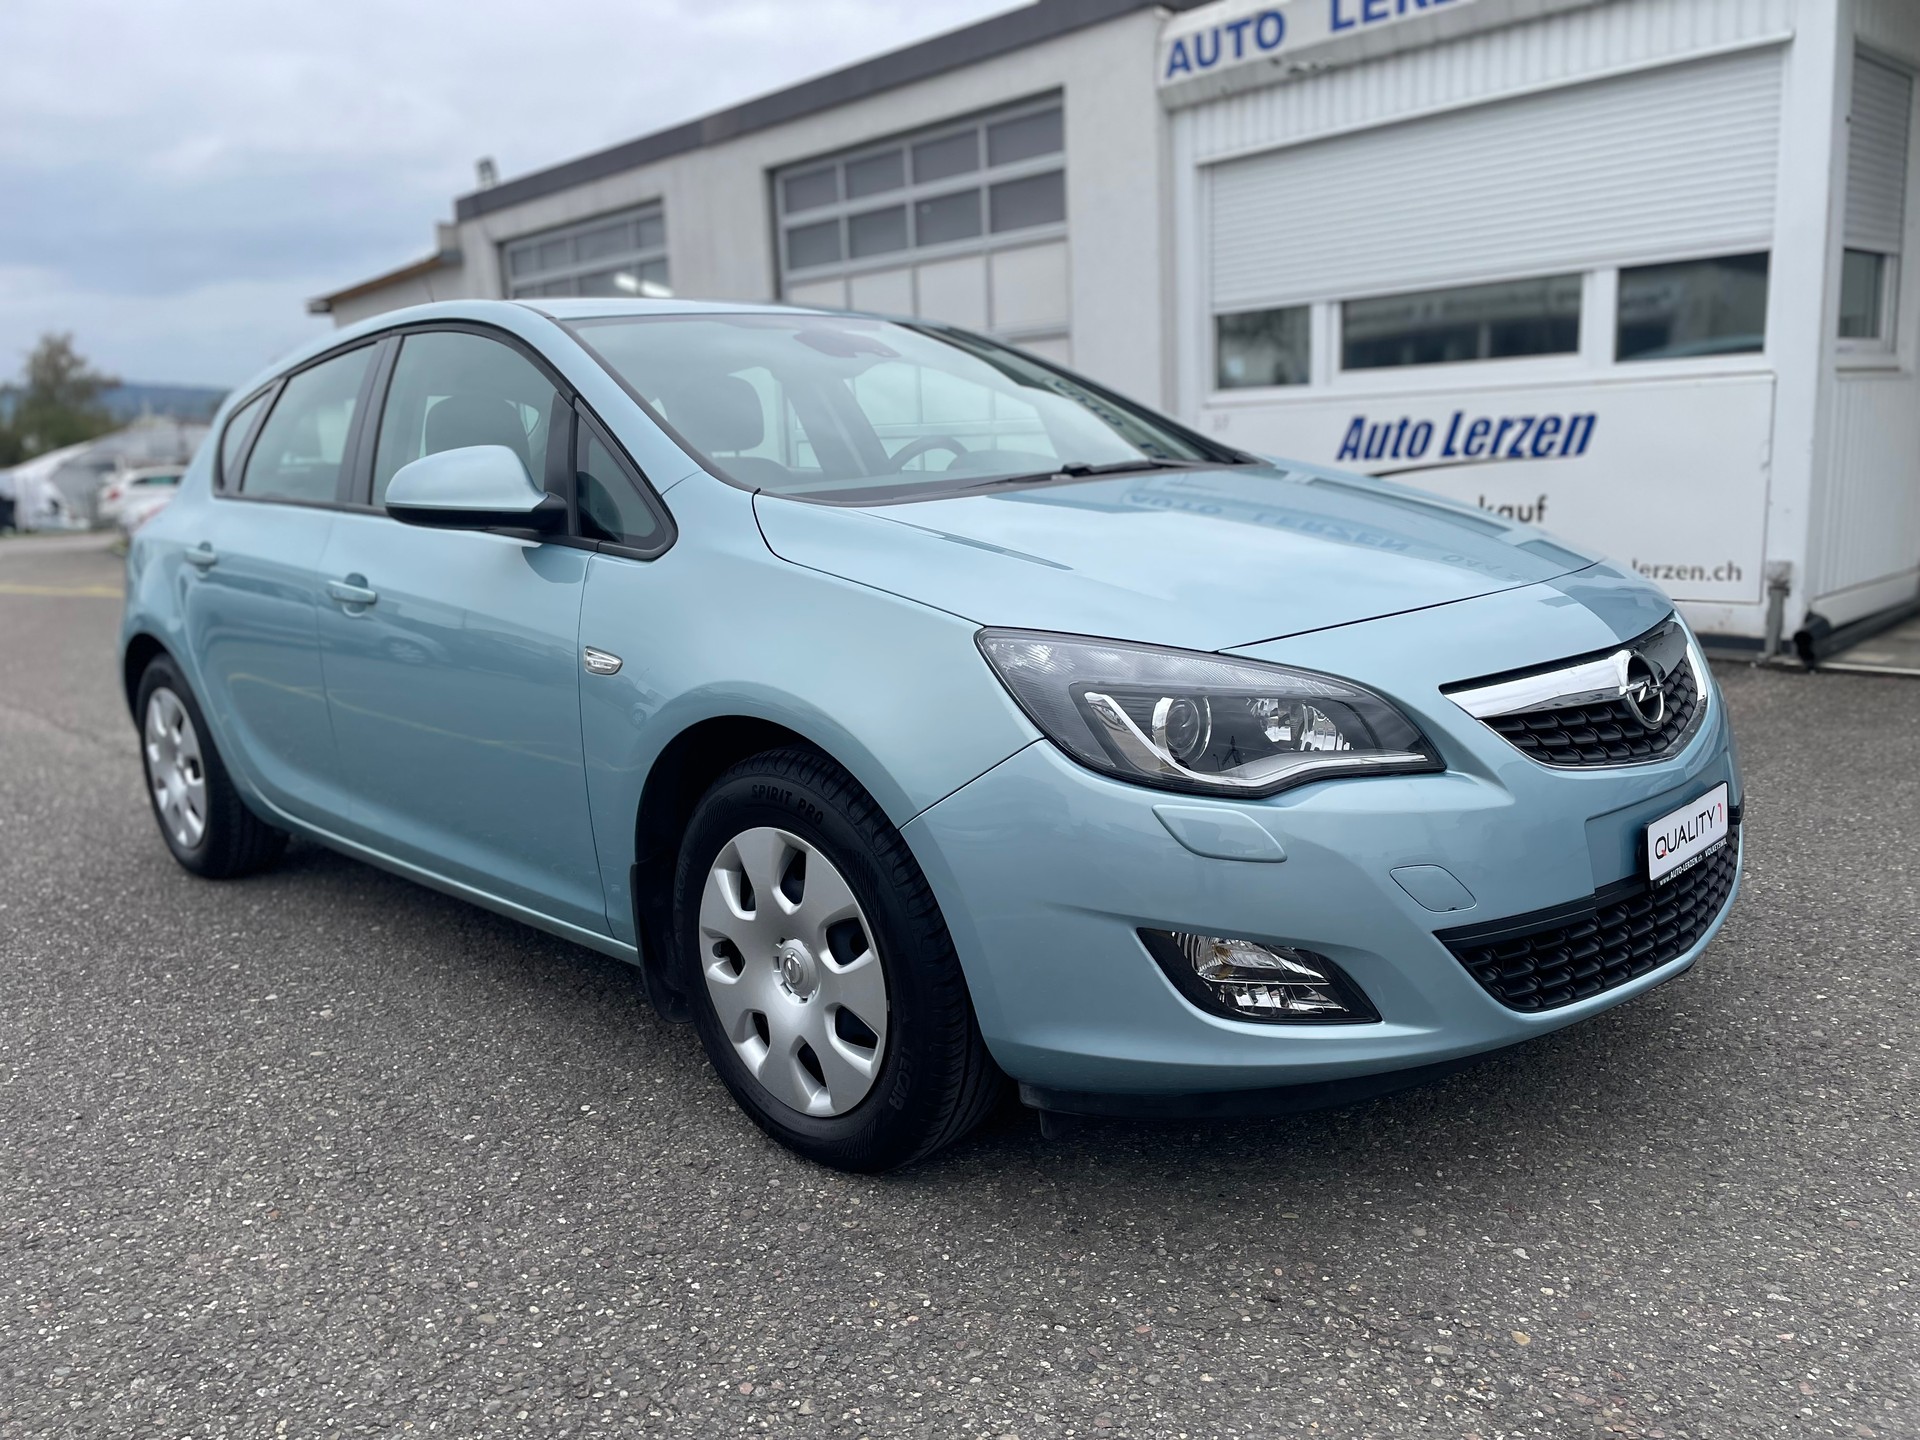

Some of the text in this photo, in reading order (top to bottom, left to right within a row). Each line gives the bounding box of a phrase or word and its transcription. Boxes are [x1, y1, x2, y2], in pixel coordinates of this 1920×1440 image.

[1166, 9, 1285, 79] AUTO
[1336, 409, 1598, 461] Auto Lerzen
[750, 784, 824, 825] SPIRIT PRO
[1655, 805, 1716, 860] QUALITY
